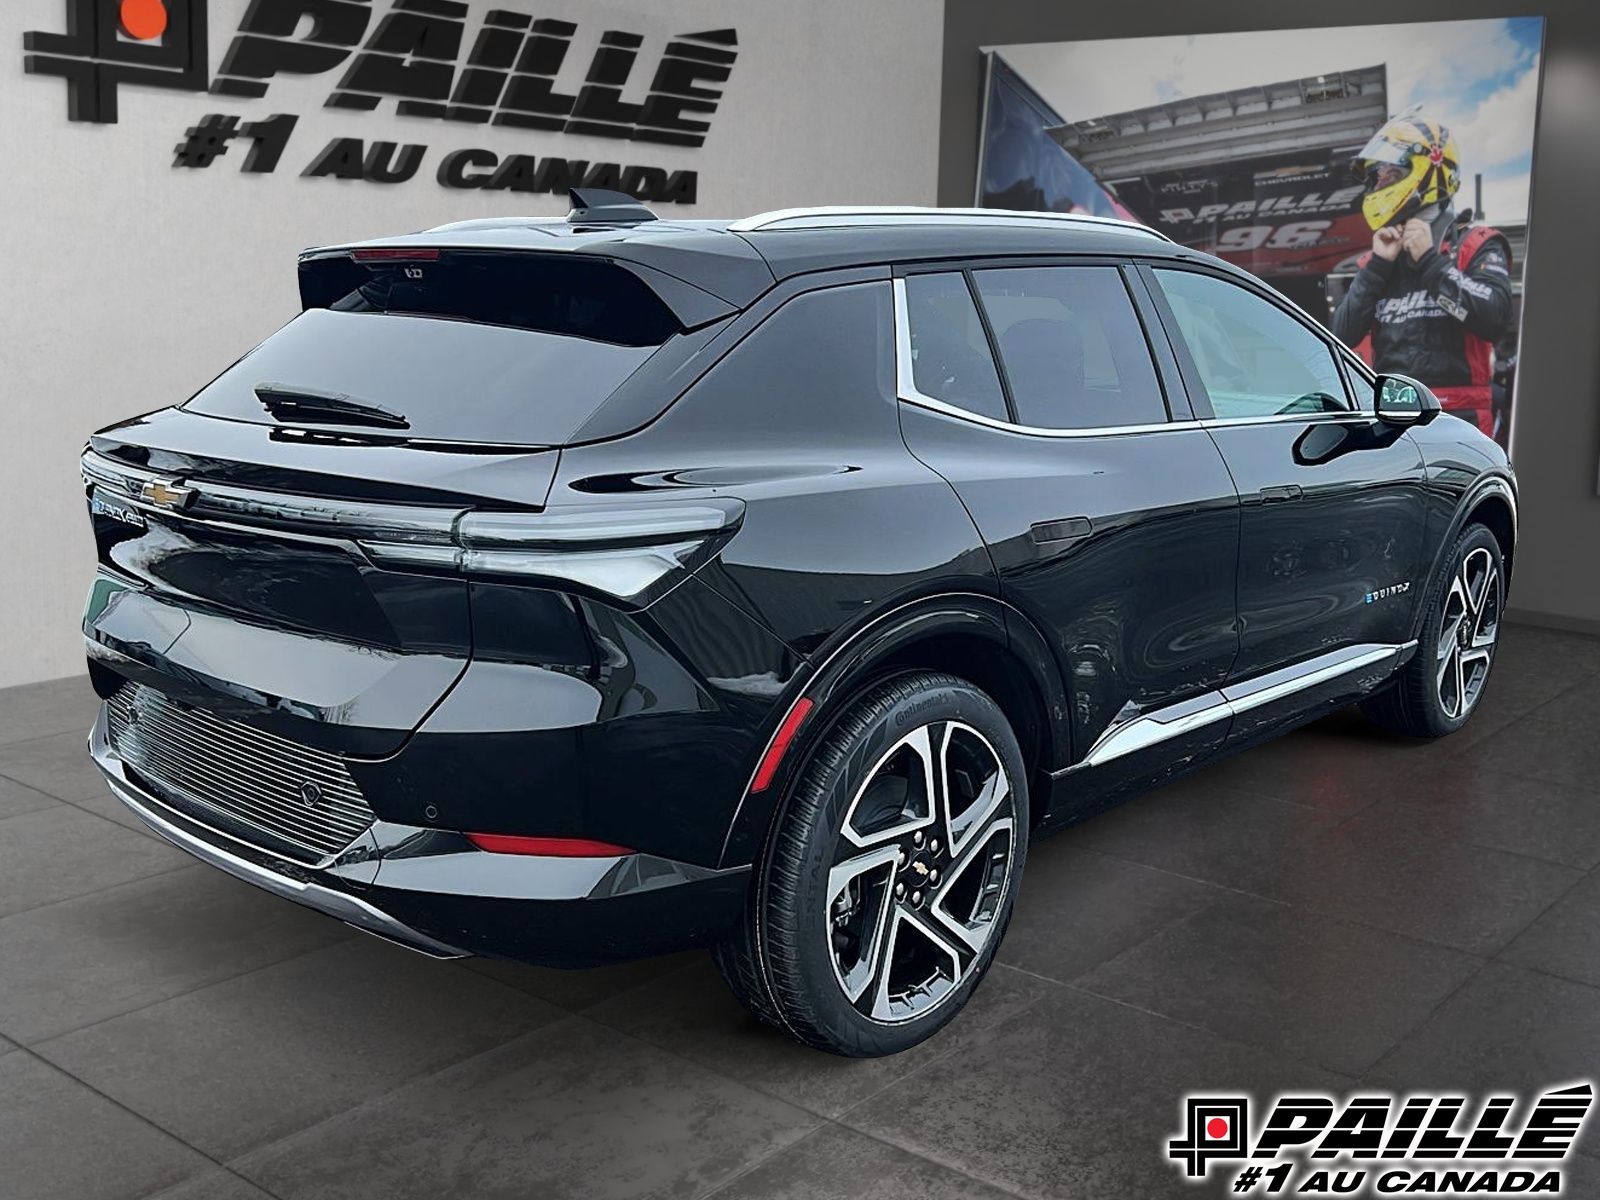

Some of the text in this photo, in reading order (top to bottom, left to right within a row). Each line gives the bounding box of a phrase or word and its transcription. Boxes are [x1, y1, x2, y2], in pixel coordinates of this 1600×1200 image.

[208, 0, 738, 148] PAILLÉ
[171, 113, 698, 205] #1 AU CANADA
[1254, 172, 1330, 187] CHEVROLET
[1258, 202, 1351, 217] CANADA
[1216, 220, 1332, 251] 96
